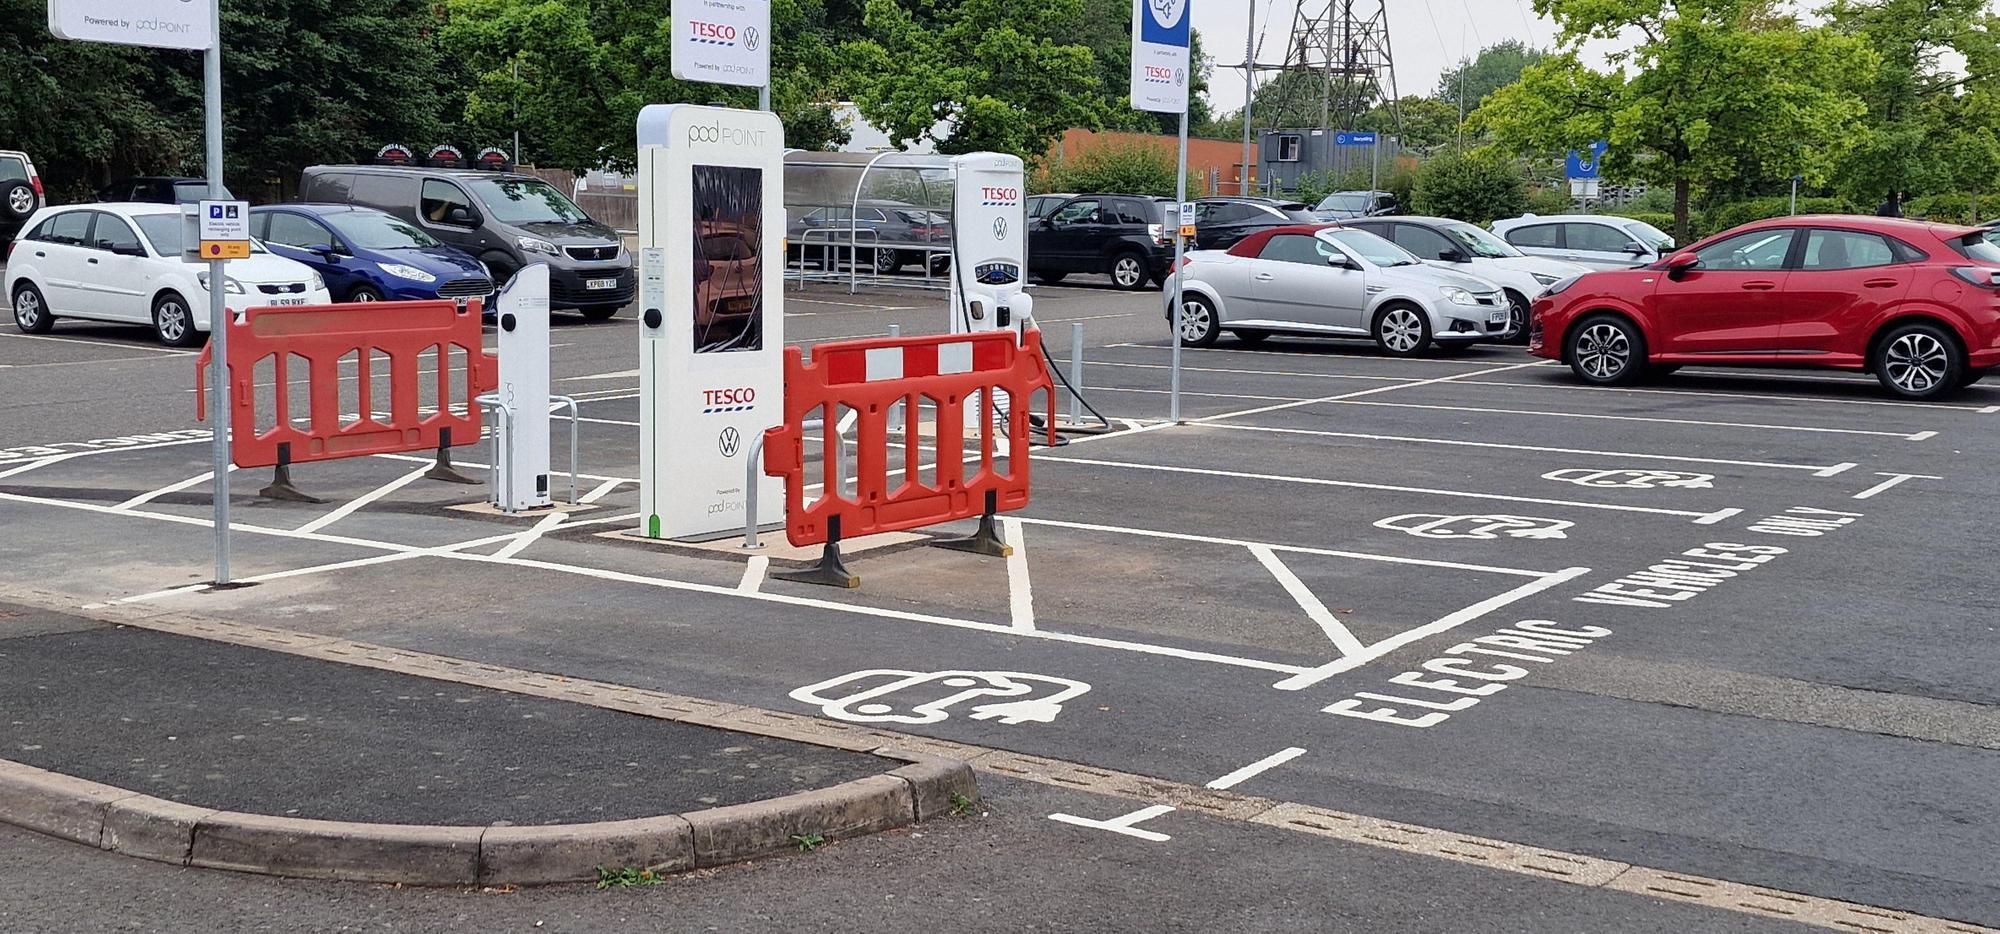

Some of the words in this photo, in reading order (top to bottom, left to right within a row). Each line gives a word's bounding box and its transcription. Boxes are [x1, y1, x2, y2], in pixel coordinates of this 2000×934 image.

[84, 15, 119, 27] Powered
[120, 19, 130, 30] by
[159, 21, 191, 34] POINT
[690, 21, 736, 40] TESCO
[1145, 66, 1171, 79] TESCO
[722, 127, 767, 147] POINT
[982, 187, 1018, 200] TESCO
[703, 388, 756, 406] TESCO
[1321, 618, 1612, 728] ELECTRIC
[1572, 541, 1789, 608] VEHICLES
[1747, 506, 1865, 537] ONLY
